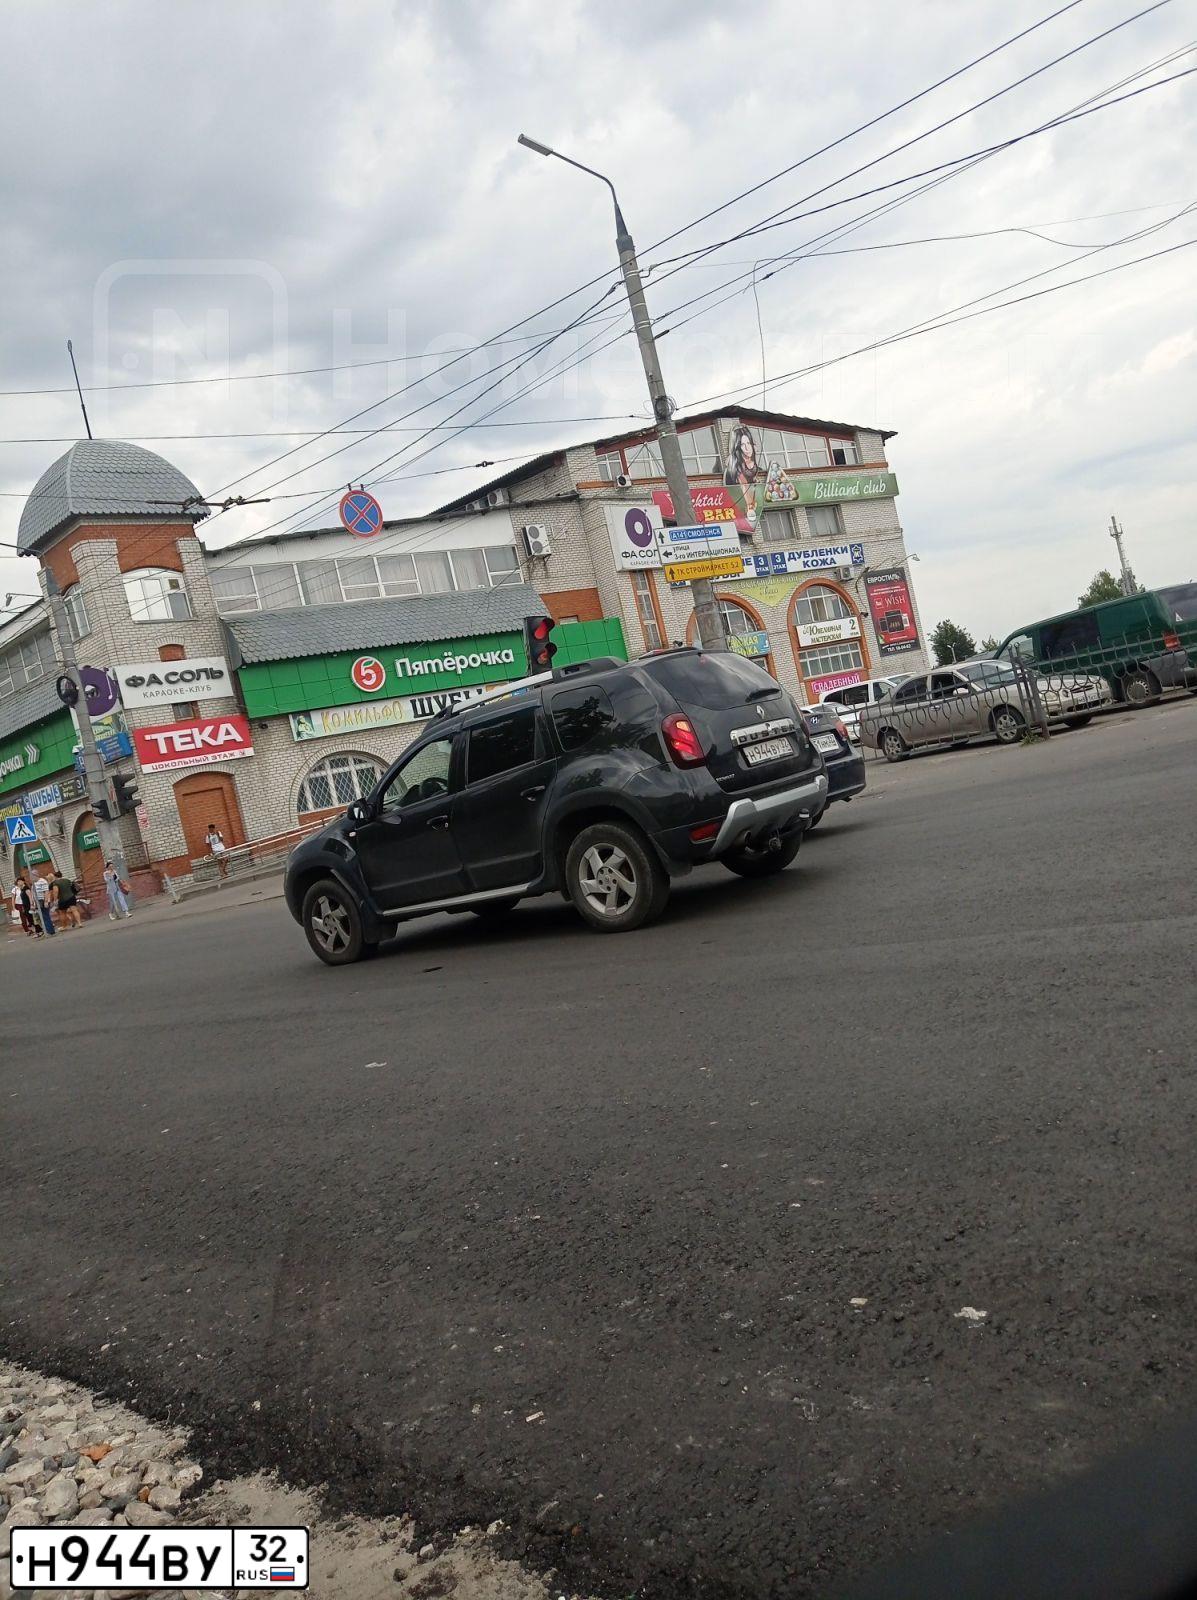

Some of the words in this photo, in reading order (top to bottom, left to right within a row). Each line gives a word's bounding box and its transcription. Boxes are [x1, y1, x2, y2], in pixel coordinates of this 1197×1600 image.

[814, 480, 859, 499] Billiard
[863, 479, 886, 494] club
[703, 507, 736, 521] BAR
[686, 547, 740, 559] ИНТЕРНАЦИОНАЛА
[758, 556, 765, 566] 3
[775, 553, 782, 563] 3
[787, 545, 848, 562] ДУБЛЕНКИ
[686, 562, 729, 575] СТРОЙМАРКЕТ
[803, 557, 837, 569] КОЖА
[849, 619, 856, 630] 2
[395, 649, 515, 678] Пятёрочка
[143, 685, 212, 698] КАРАОКЕ-КЛУБ
[813, 674, 861, 693] СВАДЕБНЫЙ
[321, 700, 404, 731] КОМИЛЬФО
[144, 722, 244, 755] ТЕКА
[738, 724, 796, 743] DUSTER
[748, 742, 780, 761] Н944ВУ
[0, 755, 23, 777] очка
[152, 756, 209, 771] ЦОКОЛЬНЫЙ
[211, 752, 236, 761] ЭТАЖ
[32, 784, 55, 809] ШУБЫ
